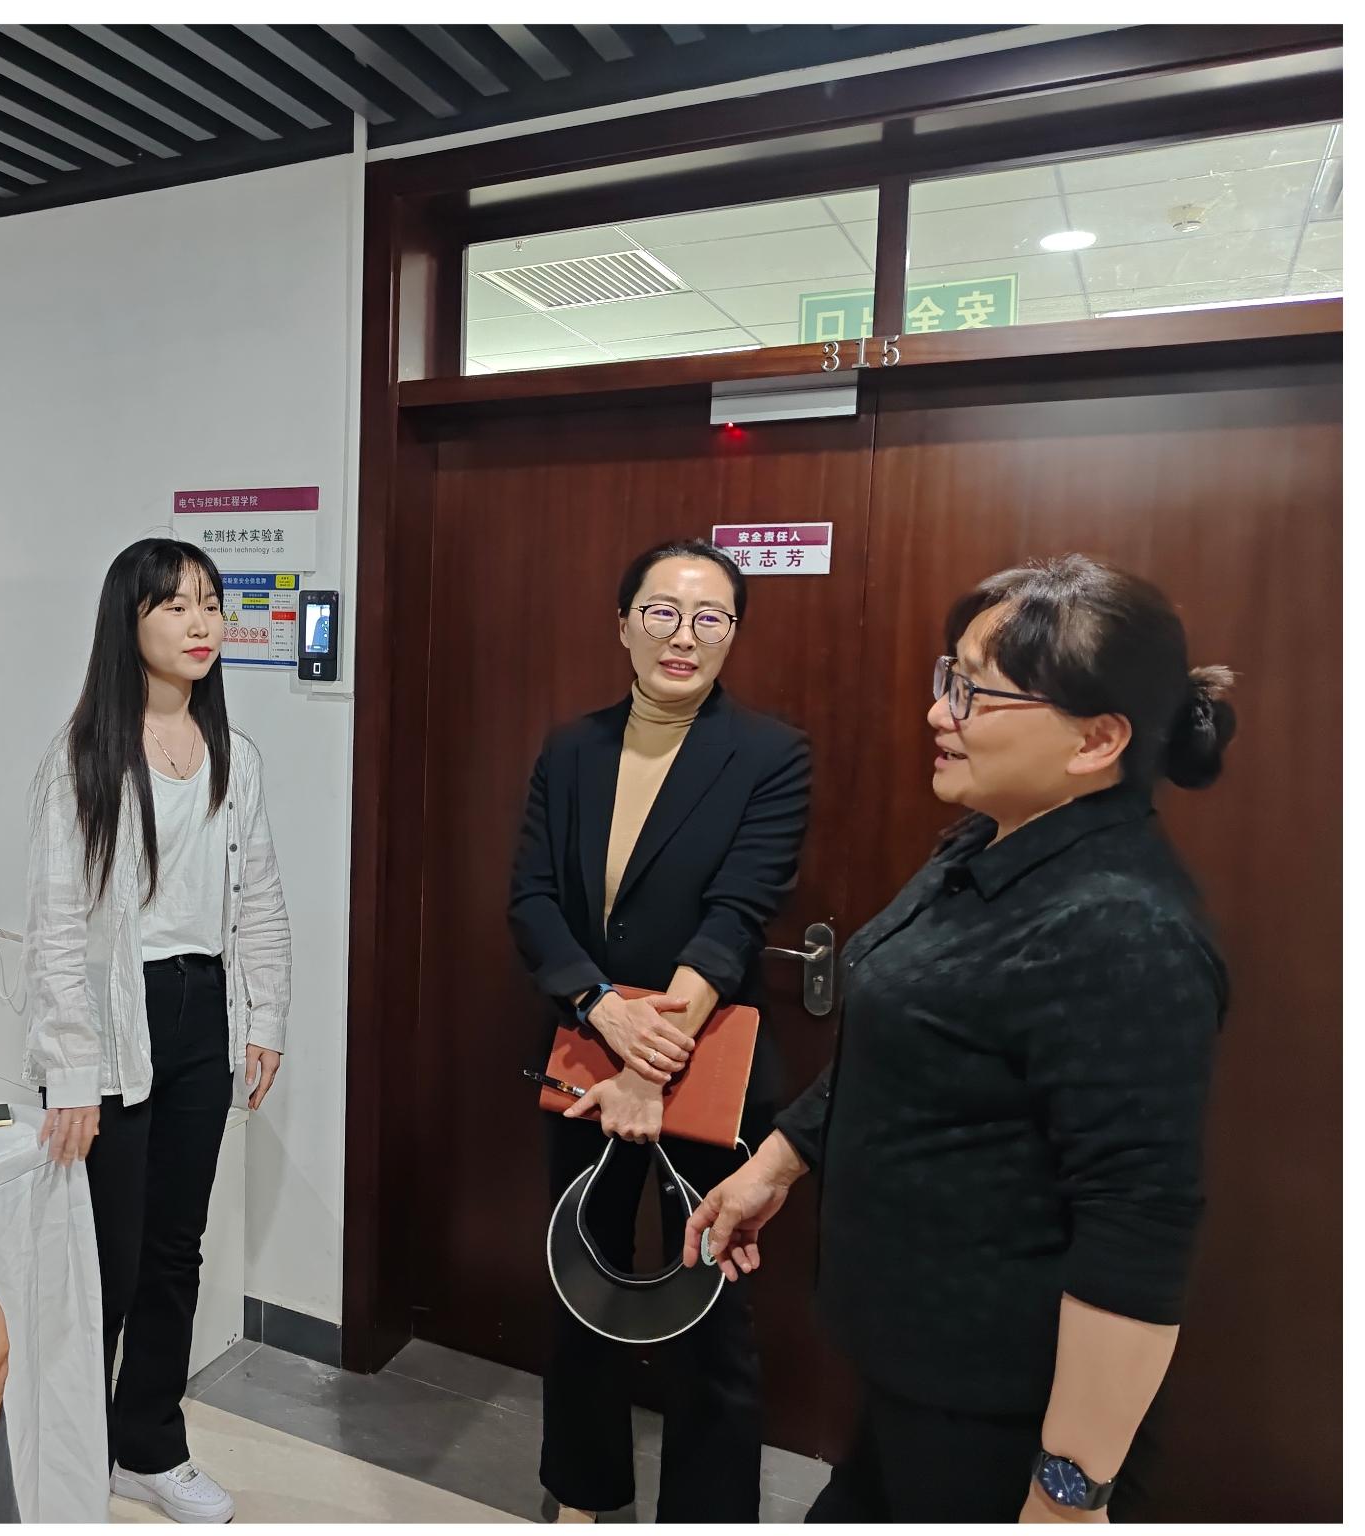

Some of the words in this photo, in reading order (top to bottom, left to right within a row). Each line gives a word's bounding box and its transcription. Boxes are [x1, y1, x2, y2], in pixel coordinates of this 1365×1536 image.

[821, 335, 902, 372] 315
[179, 495, 259, 509] 电气与控制工程学院
[203, 529, 285, 543] 检测技术实验室
[738, 531, 801, 543] 安全责任人
[733, 549, 805, 568] 张志芳
